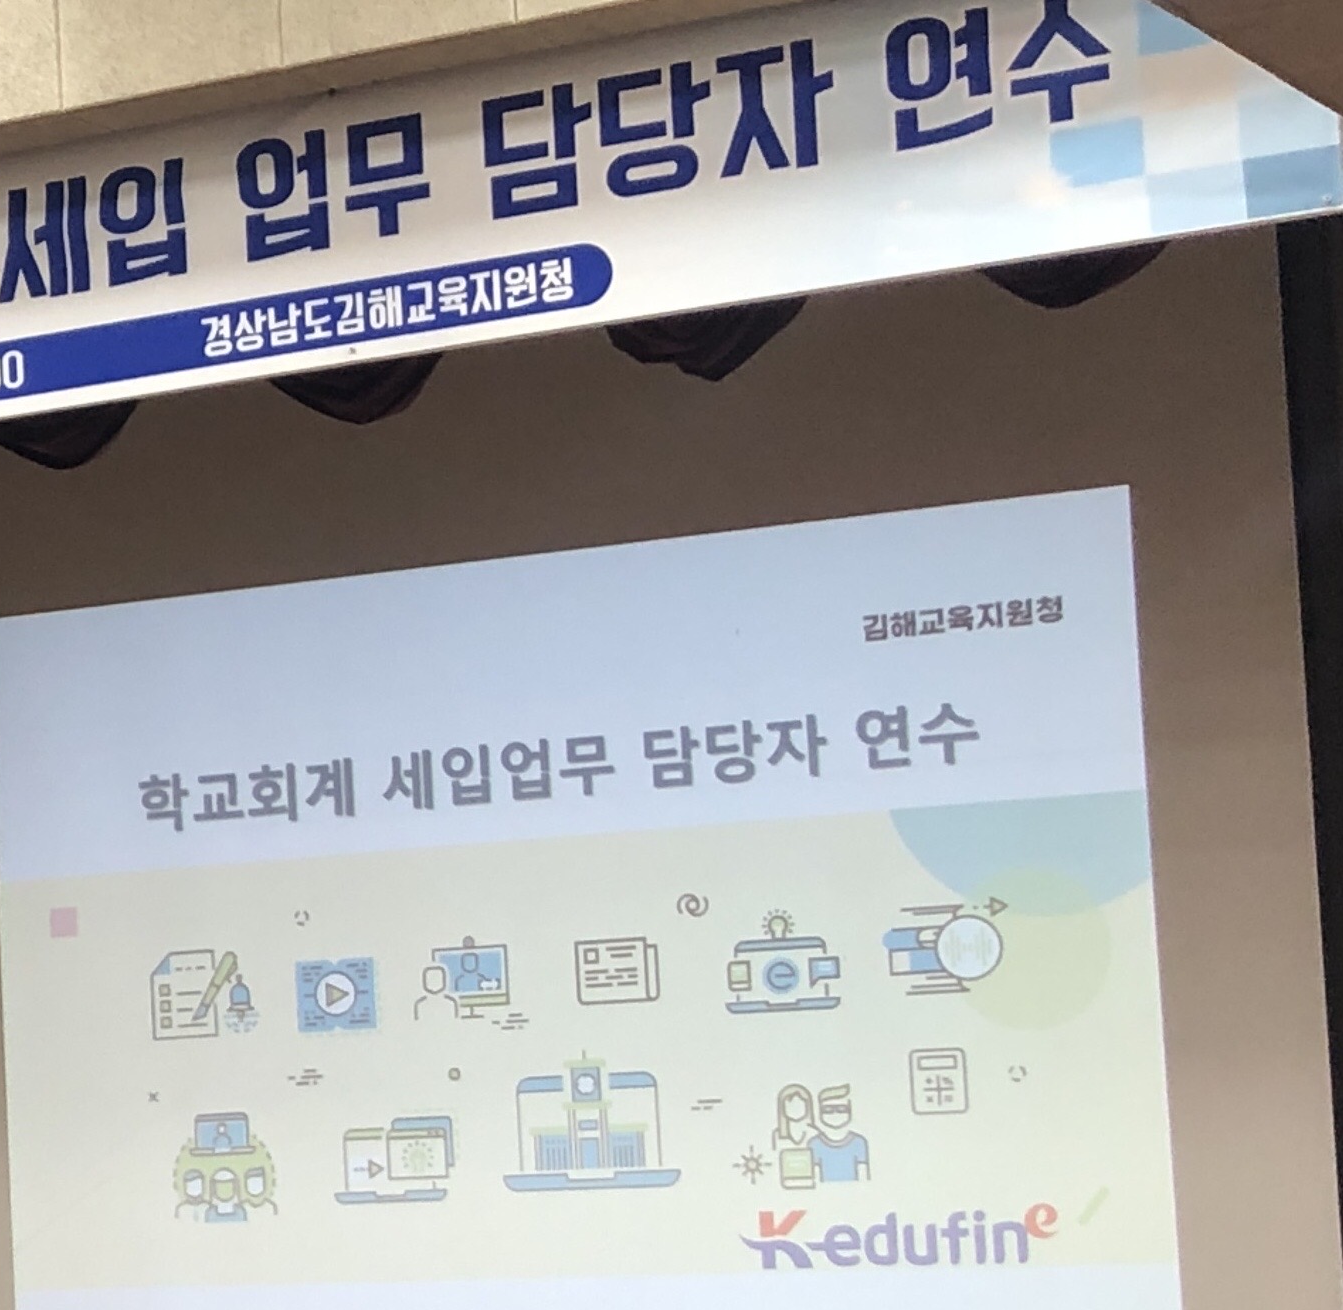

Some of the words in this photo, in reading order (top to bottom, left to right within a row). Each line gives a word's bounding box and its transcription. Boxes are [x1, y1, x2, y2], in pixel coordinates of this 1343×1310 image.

[236, 113, 430, 262] 업무
[480, 38, 833, 221] 담당자
[885, 0, 1111, 151] 연수
[200, 256, 575, 358] 경상남도김해교육지원청
[863, 595, 1064, 642] 김해교육지원청
[138, 757, 355, 832] 학교회계
[382, 735, 616, 811] 세입업무
[643, 714, 827, 788] 담당자
[856, 703, 980, 770] 연수
